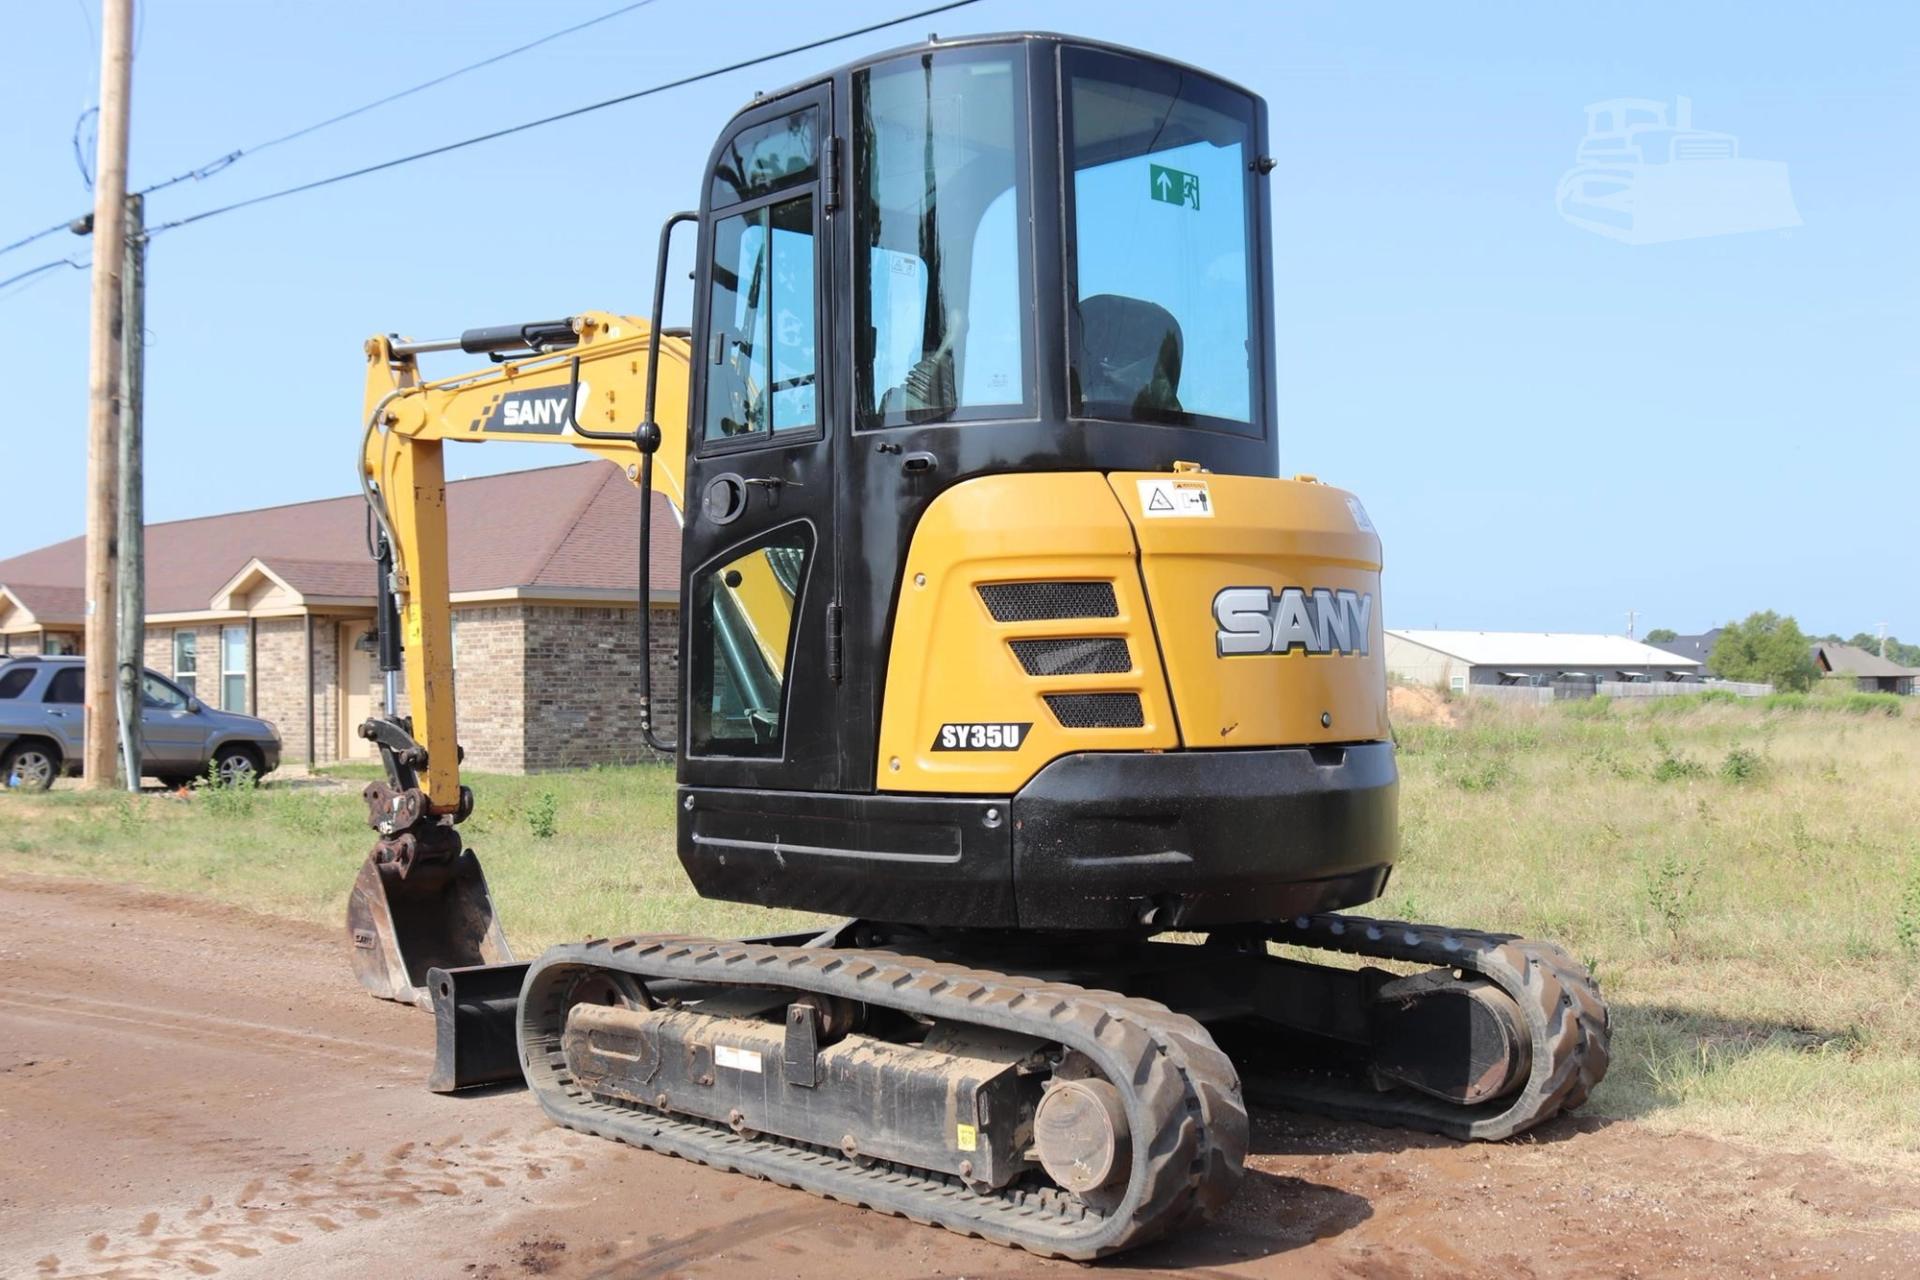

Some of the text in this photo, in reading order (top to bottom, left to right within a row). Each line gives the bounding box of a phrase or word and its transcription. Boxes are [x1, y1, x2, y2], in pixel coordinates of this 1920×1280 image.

[503, 398, 568, 426] SANY
[1212, 586, 1372, 658] SANY
[942, 725, 1019, 748] SY35U
